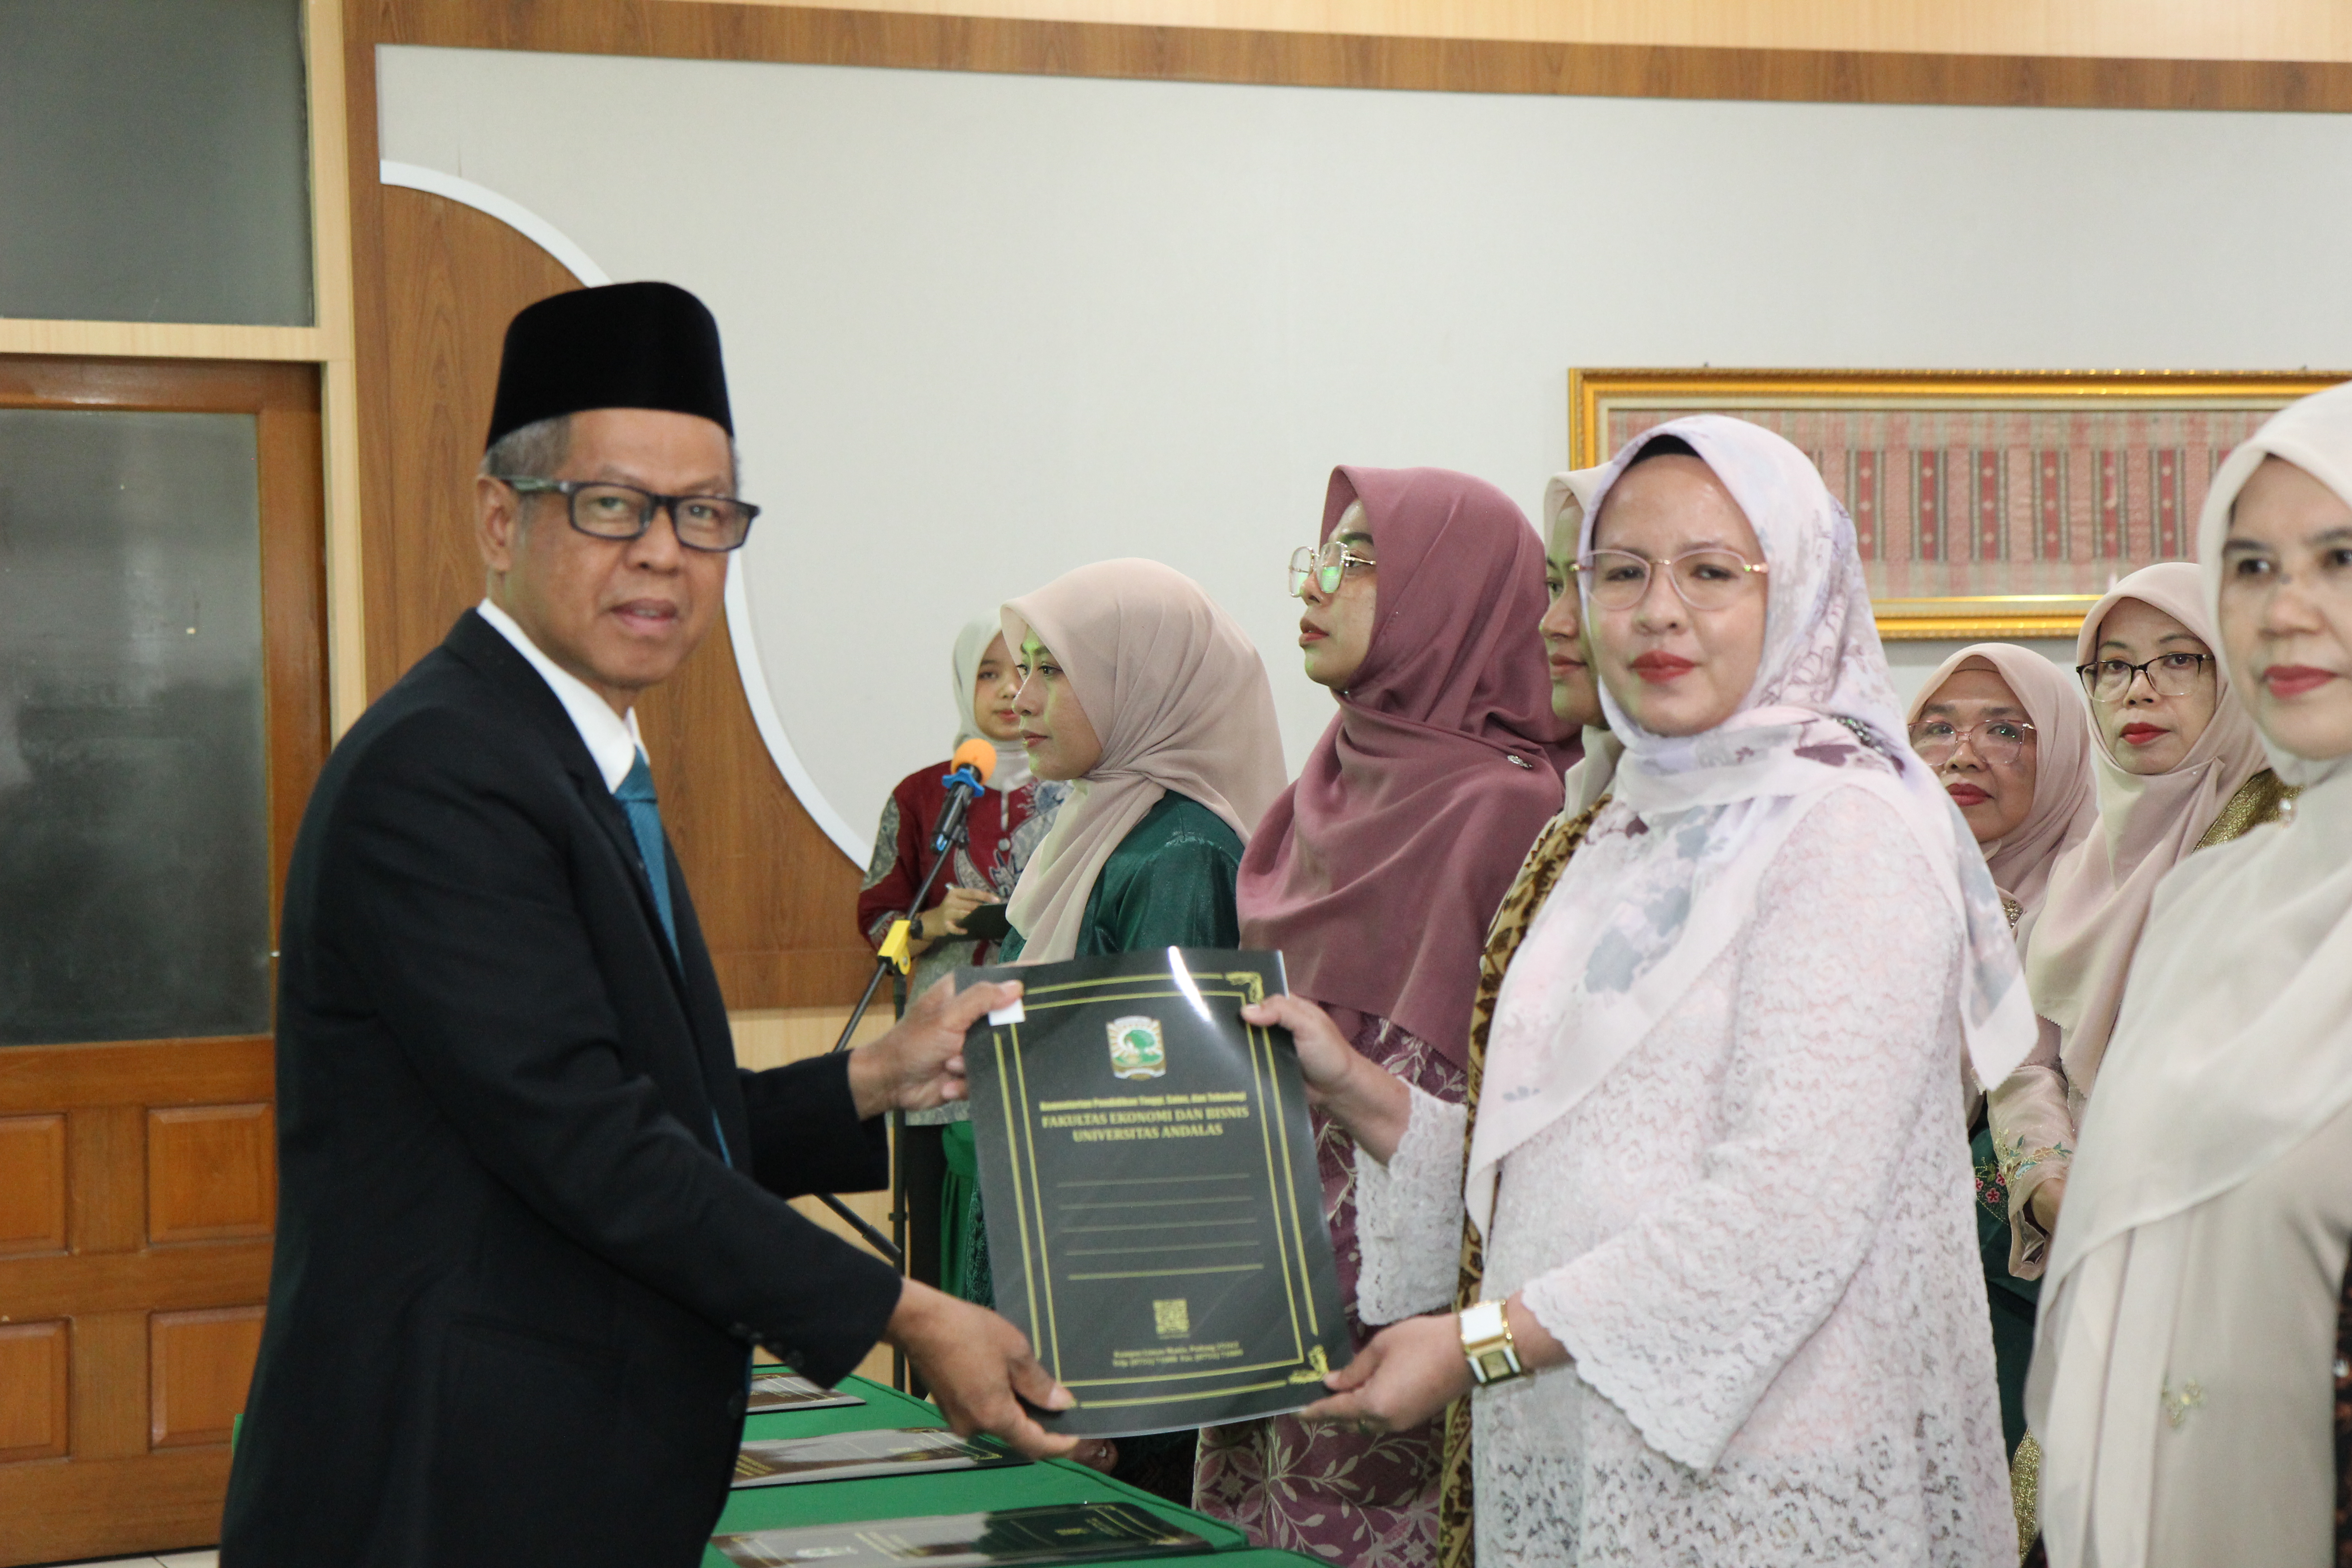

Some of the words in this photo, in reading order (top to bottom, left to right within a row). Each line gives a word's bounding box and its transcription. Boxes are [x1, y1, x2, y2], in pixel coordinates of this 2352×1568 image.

[1042, 1112, 1108, 1128] FAKULTAS
[1109, 1109, 1173, 1125] EKONOMI
[1174, 1108, 1204, 1122] DAN
[1205, 1106, 1250, 1120] BISNIS
[1073, 1126, 1160, 1142] UNIVERSITAS
[1161, 1122, 1224, 1138] ANDALAS
